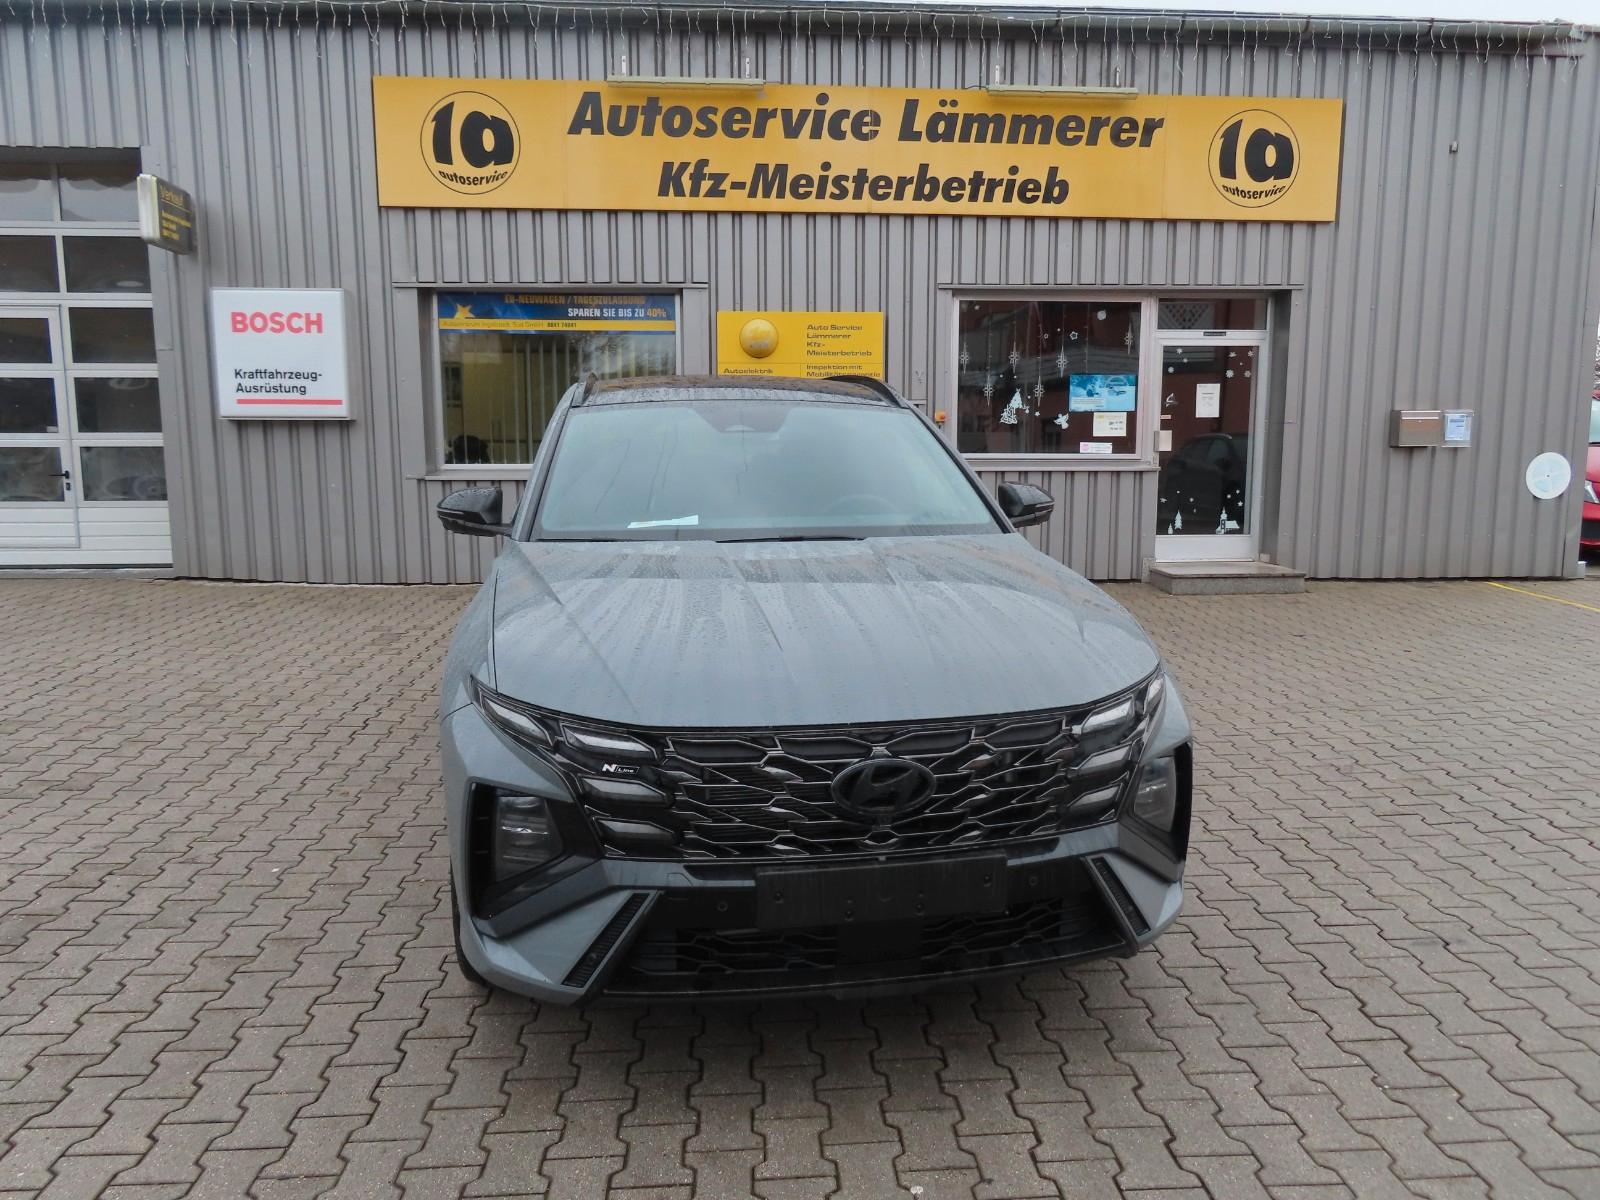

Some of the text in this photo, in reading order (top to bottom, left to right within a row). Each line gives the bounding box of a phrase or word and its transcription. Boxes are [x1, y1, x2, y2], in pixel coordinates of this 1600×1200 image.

[567, 91, 1165, 148] Autoservice Lämmerer
[430, 101, 514, 168] 1a
[1219, 118, 1294, 182] 1a
[438, 170, 508, 186] autoservice
[657, 158, 1070, 205] Kfz-Meisterbetrieb
[1222, 185, 1286, 200] autoservice
[231, 311, 323, 334] BOSCH
[567, 308, 667, 318] SPAREN SIE BIS ZU 40%
[234, 368, 323, 382] Kraftfahrzeug-
[236, 382, 307, 396] Ausrüstung
